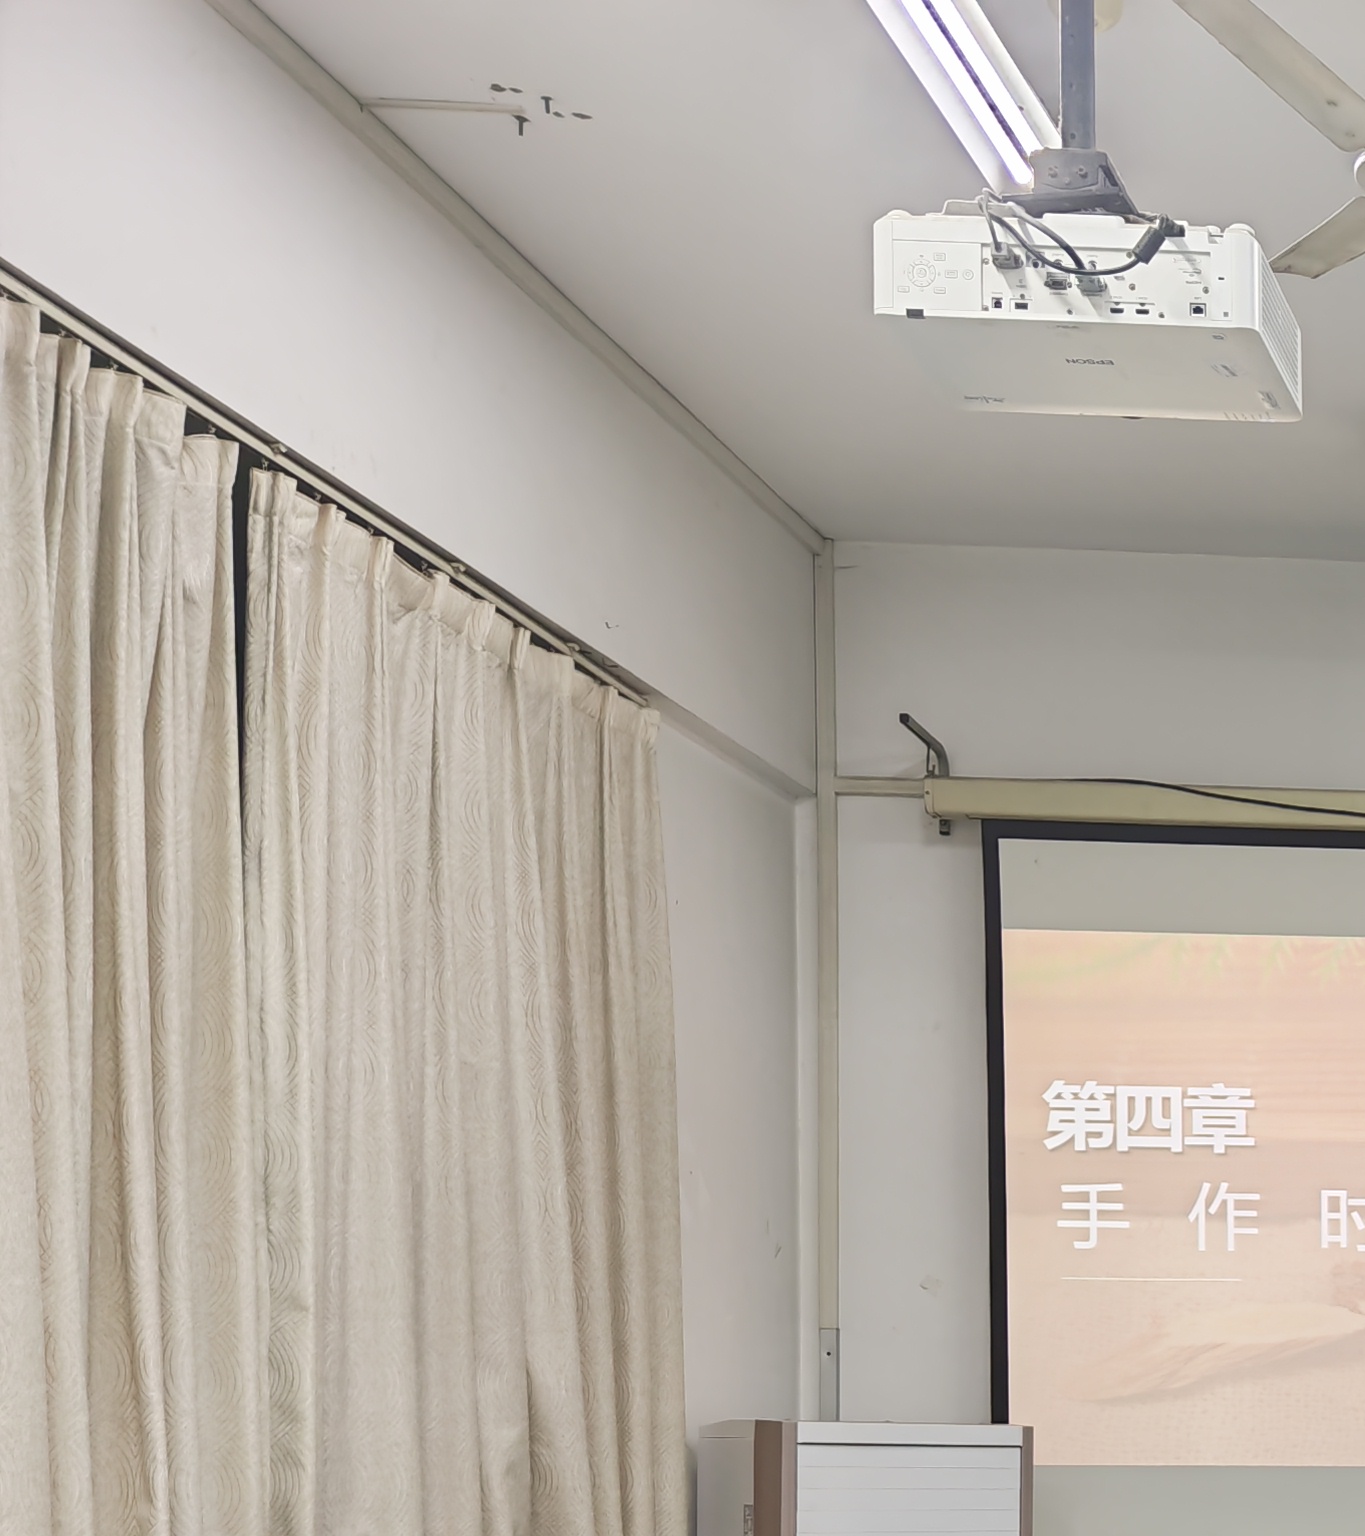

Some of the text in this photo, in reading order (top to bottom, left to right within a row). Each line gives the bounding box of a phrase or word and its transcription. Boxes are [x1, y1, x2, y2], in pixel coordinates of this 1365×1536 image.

[1065, 357, 1115, 366] EPSON
[1042, 1080, 1257, 1155] 第四章
